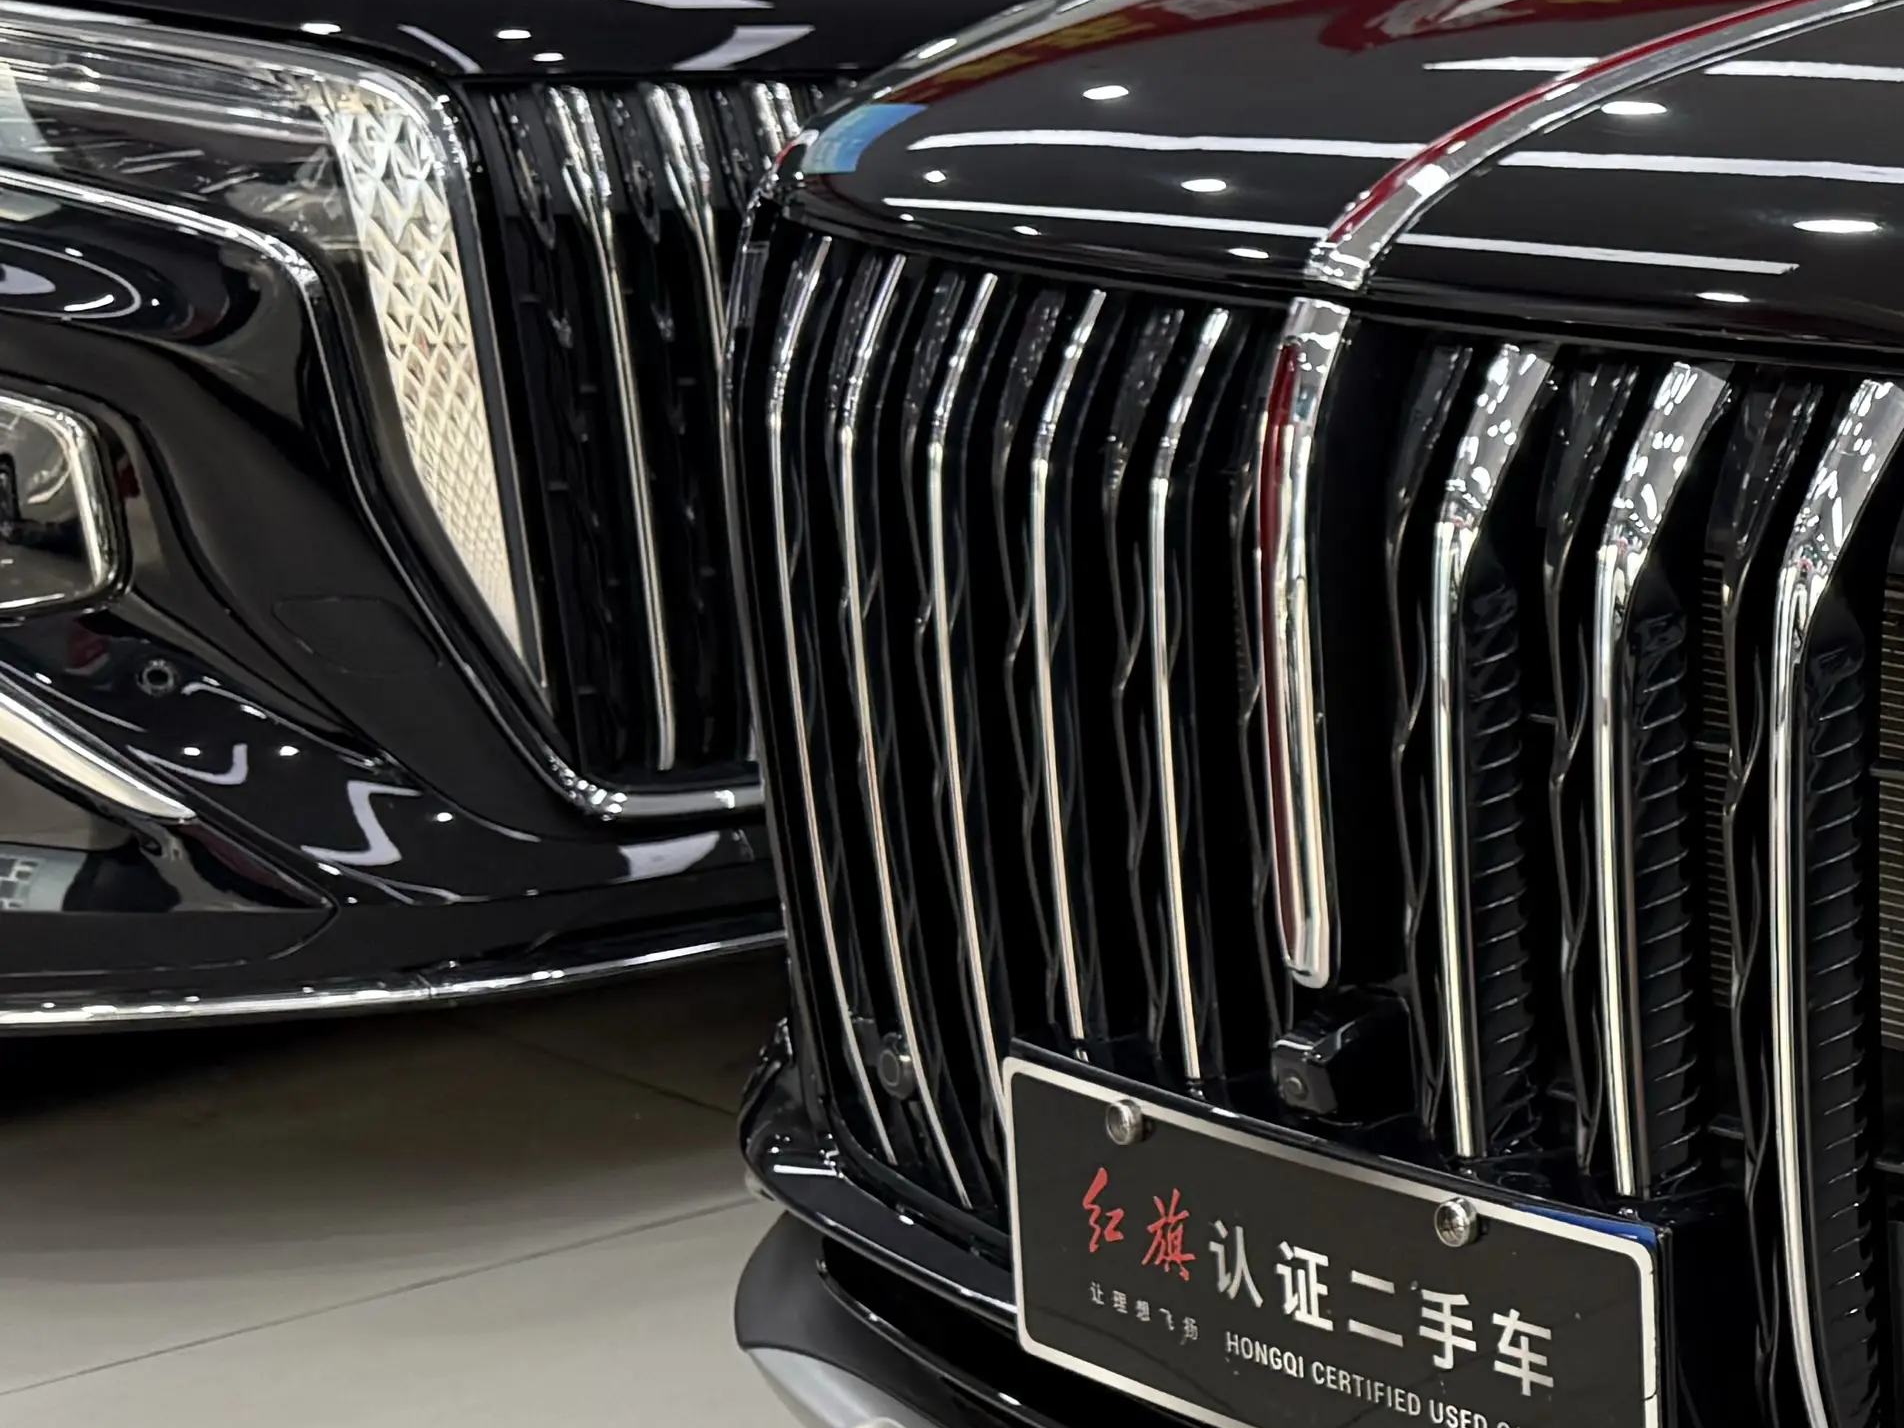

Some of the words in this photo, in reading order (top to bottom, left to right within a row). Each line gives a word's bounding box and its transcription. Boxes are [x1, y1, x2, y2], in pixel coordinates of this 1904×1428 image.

[1081, 1167, 1555, 1397] 红旗认证二手车
[1089, 1280, 1200, 1346] 让理想飞扬
[1225, 1330, 1306, 1380] HONGQI
[1311, 1360, 1422, 1419] CERTIFIED
